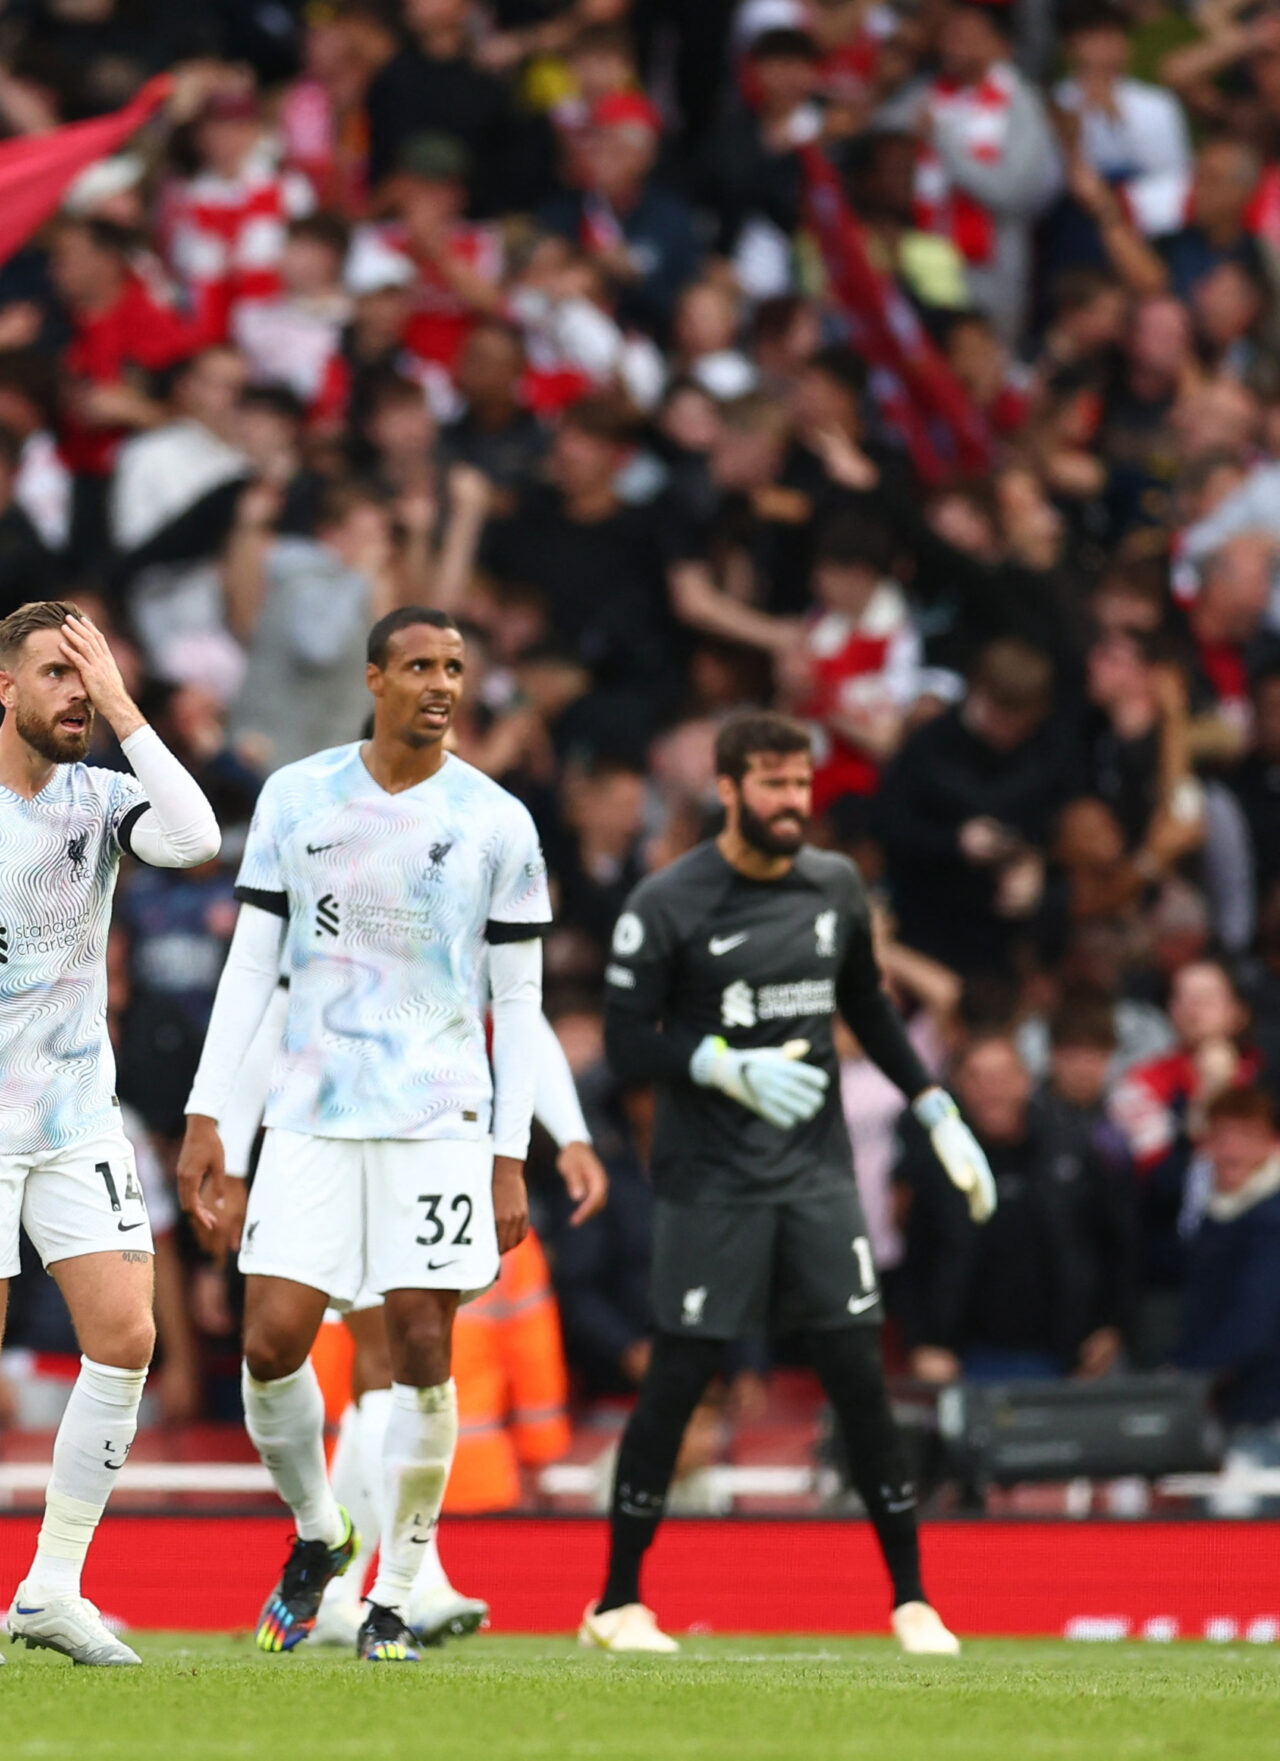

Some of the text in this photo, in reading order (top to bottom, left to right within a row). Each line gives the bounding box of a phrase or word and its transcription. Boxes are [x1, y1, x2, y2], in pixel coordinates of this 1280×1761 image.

[95, 1161, 145, 1212] 14
[415, 1193, 472, 1246] 32
[852, 1236, 875, 1293] 1
